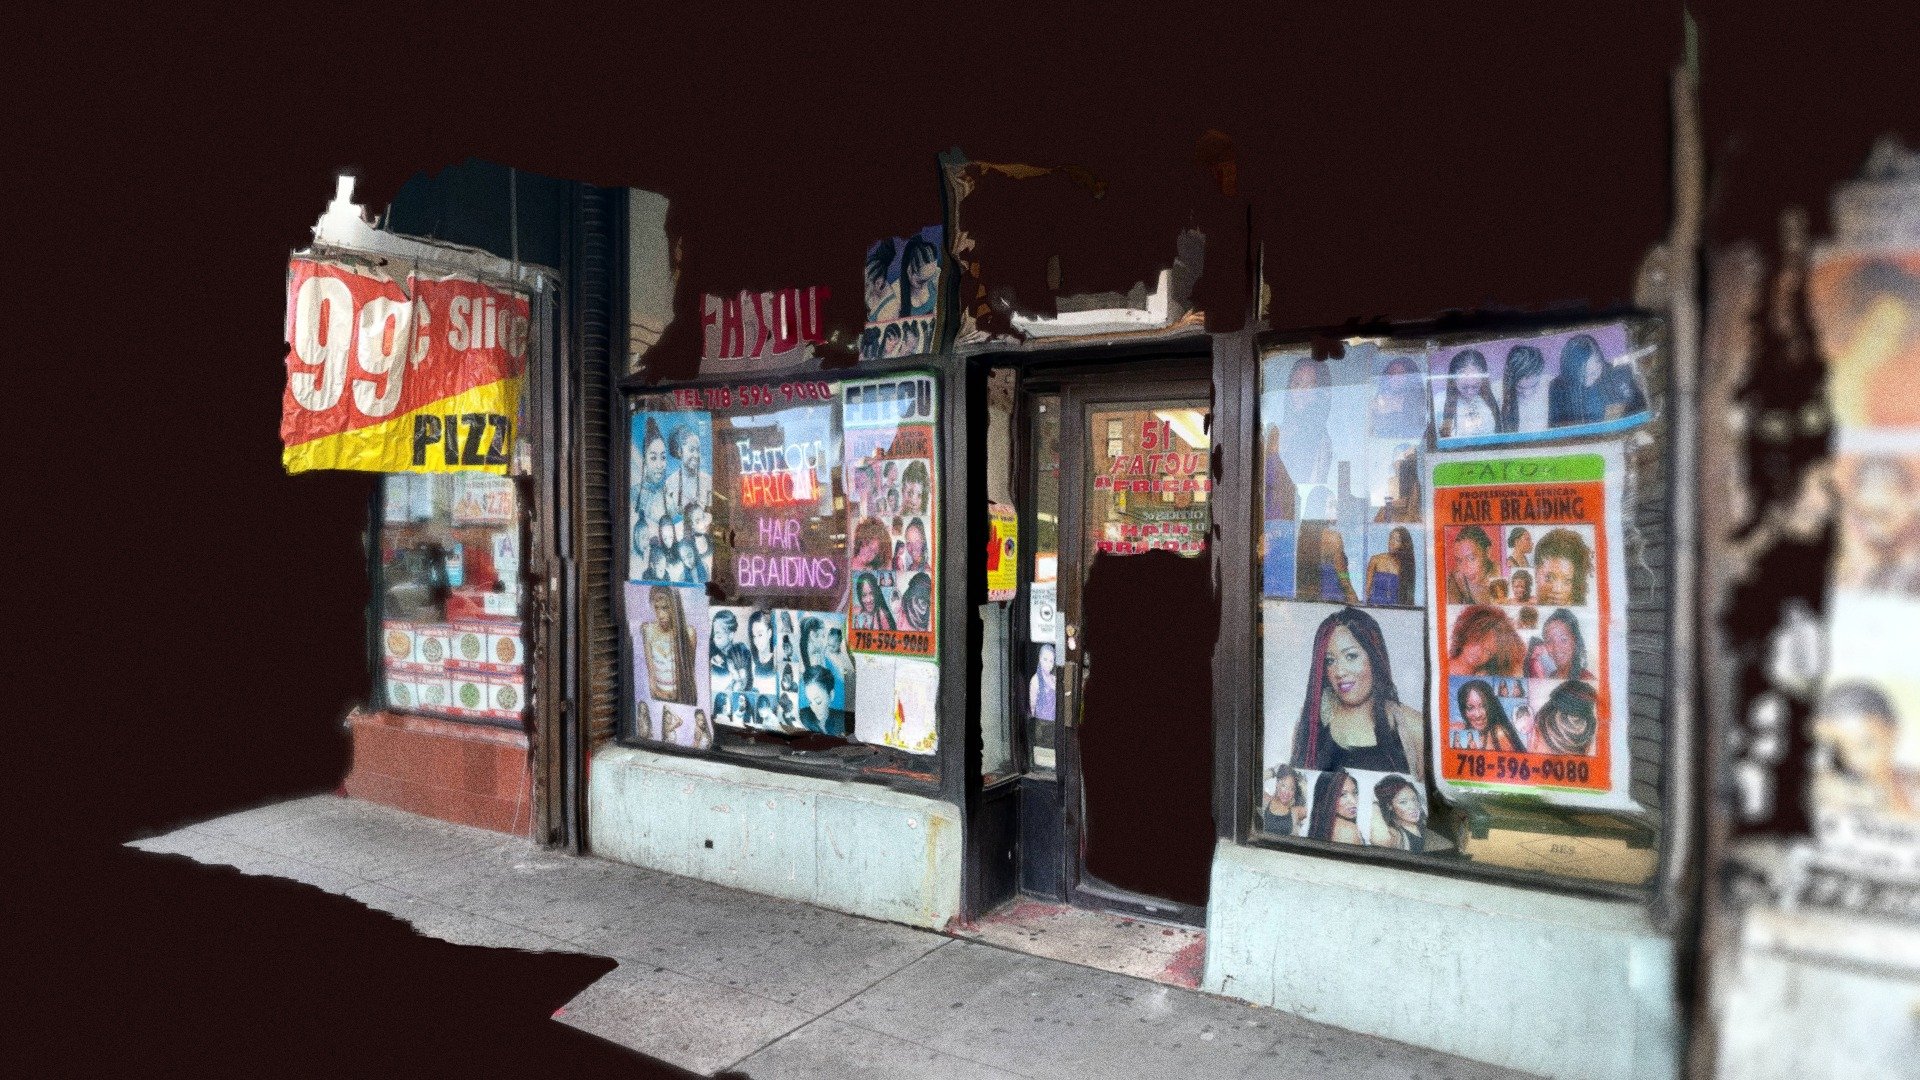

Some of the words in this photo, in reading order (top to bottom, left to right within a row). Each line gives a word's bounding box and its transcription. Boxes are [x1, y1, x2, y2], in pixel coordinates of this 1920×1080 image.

[704, 387, 731, 408] 718
[739, 384, 773, 407] 596
[779, 381, 831, 403] 9080
[1141, 420, 1170, 450] 51
[1110, 452, 1198, 476] FATOU
[1459, 489, 1529, 499] PROFESSIONAL
[1452, 498, 1492, 522] HAIR
[1501, 496, 1585, 521] BRAIDING
[759, 517, 802, 550] HAIR
[855, 631, 929, 653] 718-596-9080
[1456, 753, 1590, 783] 718-596-9080
